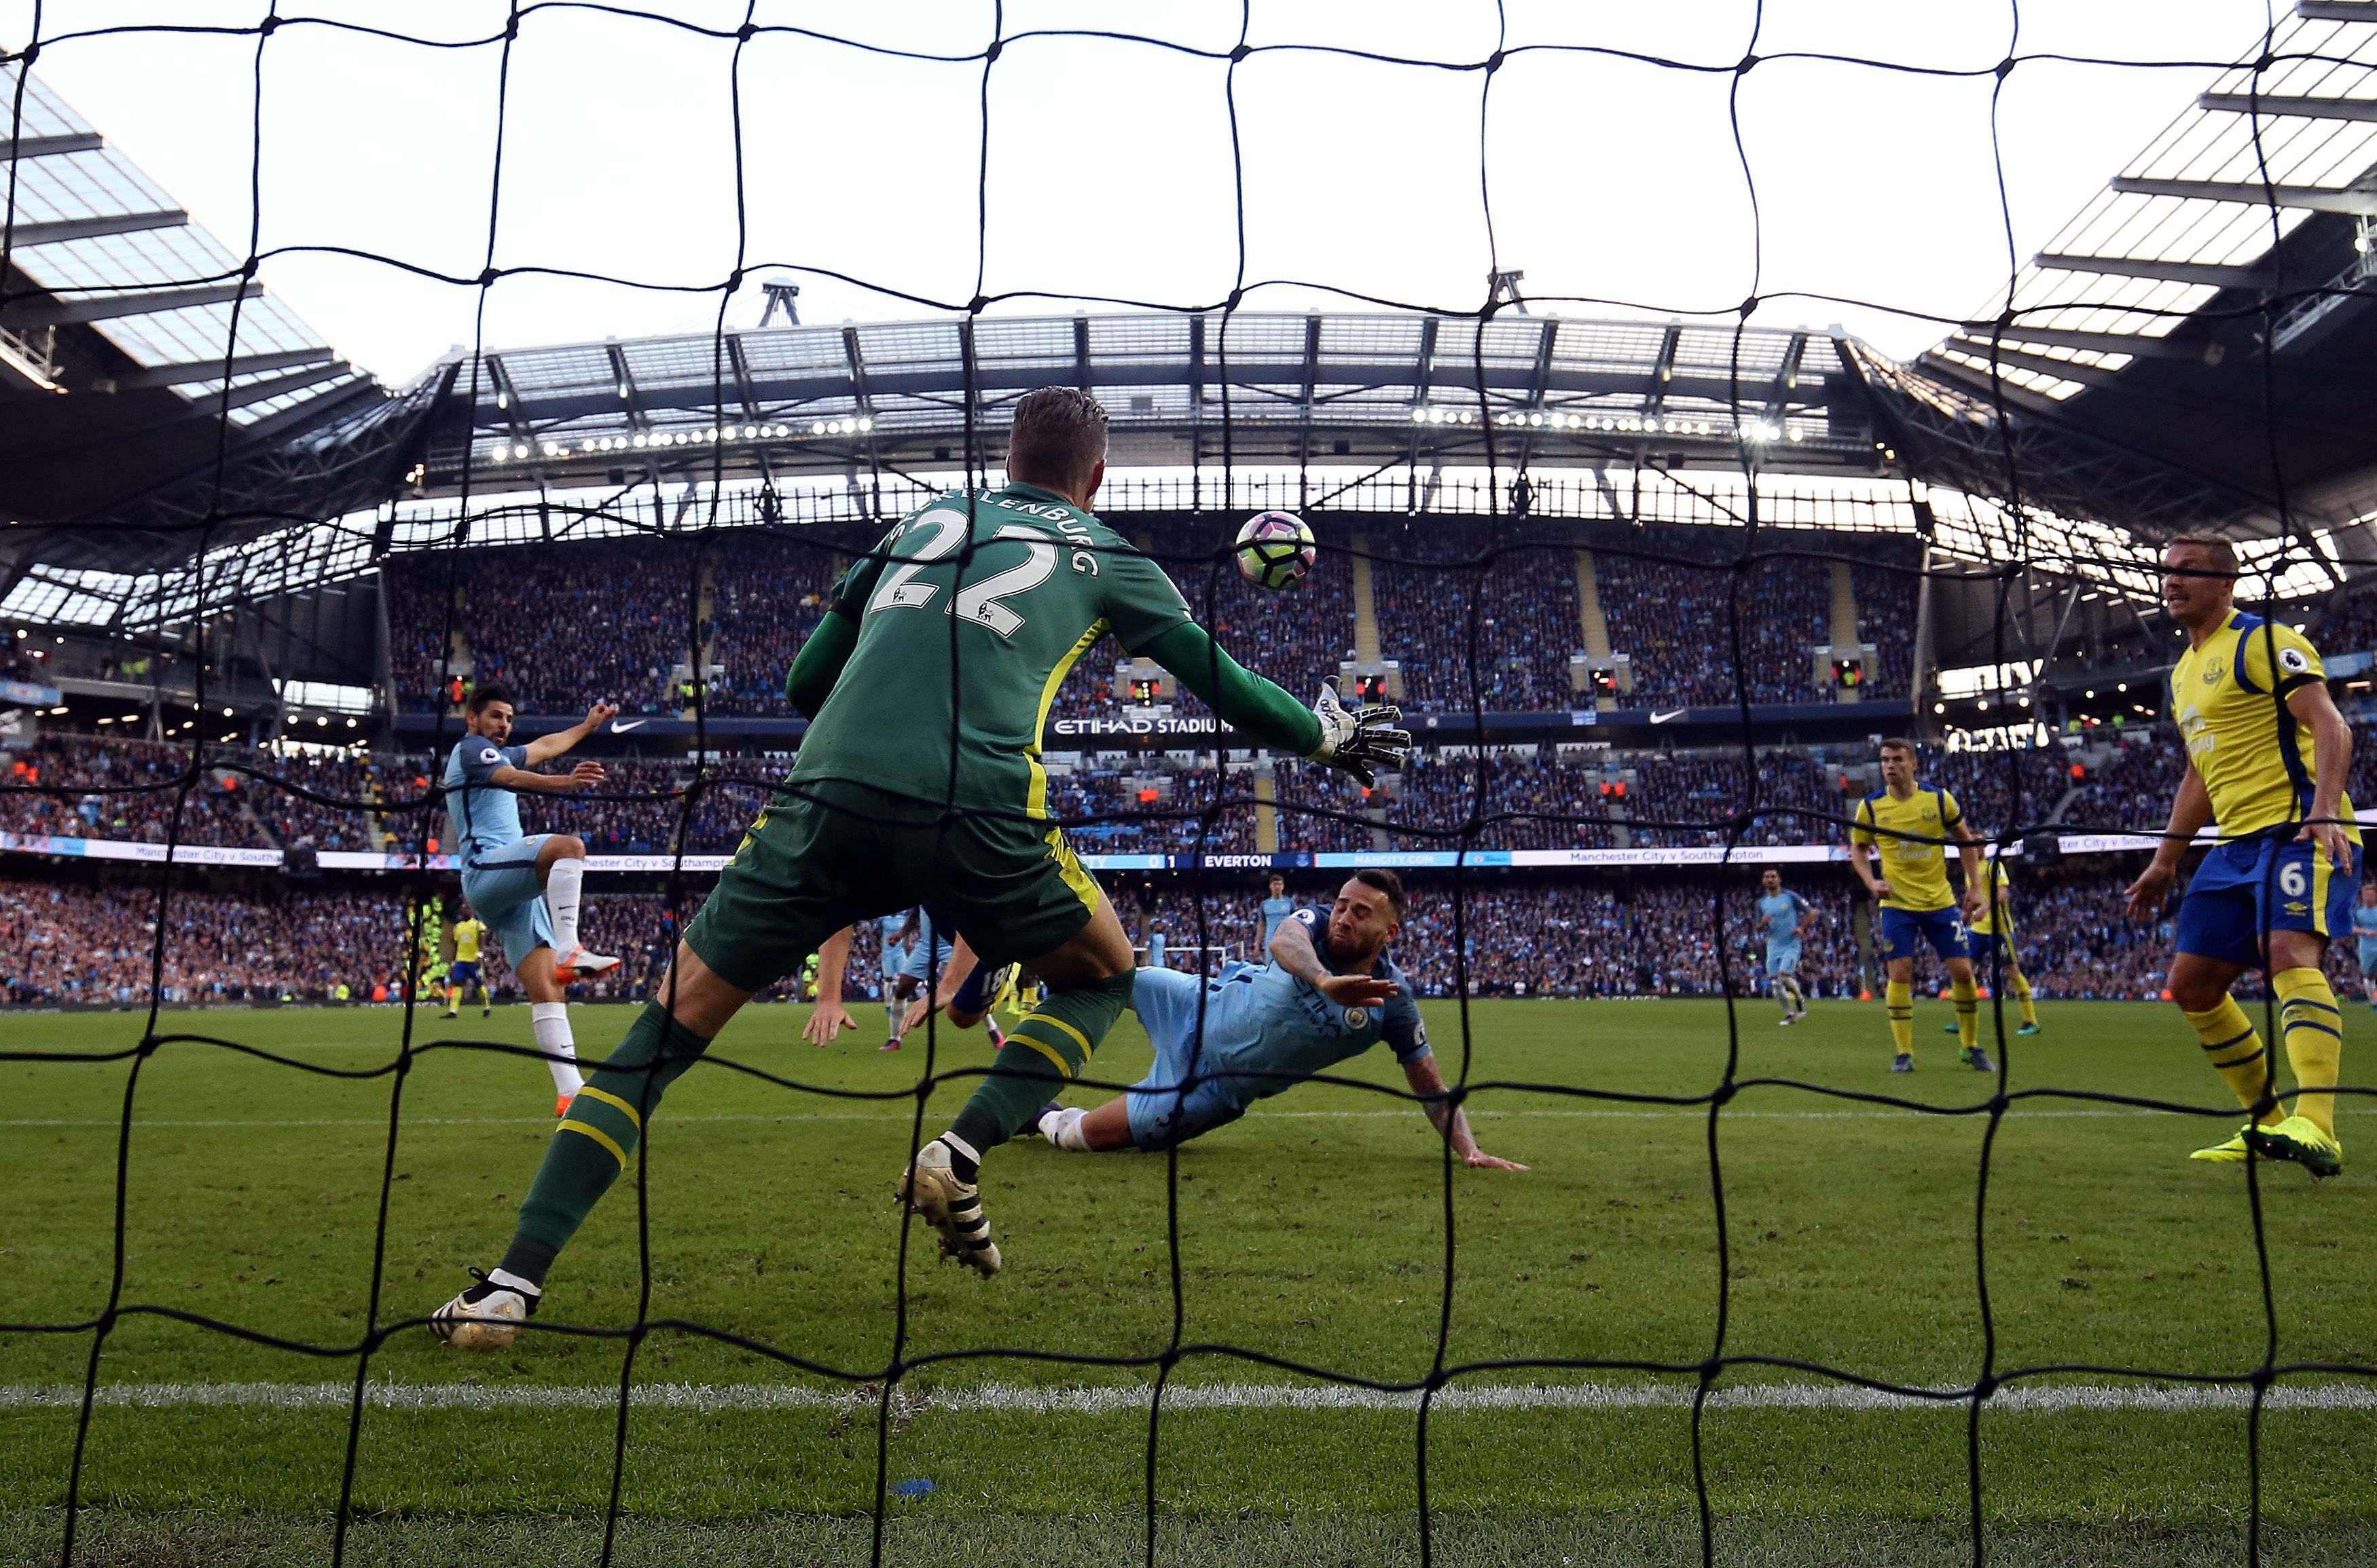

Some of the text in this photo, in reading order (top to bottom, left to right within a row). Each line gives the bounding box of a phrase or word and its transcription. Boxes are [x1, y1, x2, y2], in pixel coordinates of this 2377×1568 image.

[890, 488, 1099, 577] STKELENBURG
[869, 508, 1058, 638] 22
[1054, 718, 1234, 735] ETIHAD STADIUM
[2083, 837, 2107, 851] City
[136, 847, 198, 860] Mancester
[1354, 855, 1435, 866] MANCITY.COM
[1570, 852, 1638, 862] Manchester
[1642, 851, 1665, 864] City
[1671, 853, 1677, 861] v
[624, 858, 646, 870] City
[651, 860, 658, 868] v
[1167, 855, 1176, 869] 1
[1204, 855, 1272, 868] EVERTON
[2280, 861, 2306, 897] 6
[979, 966, 1006, 996] 18
